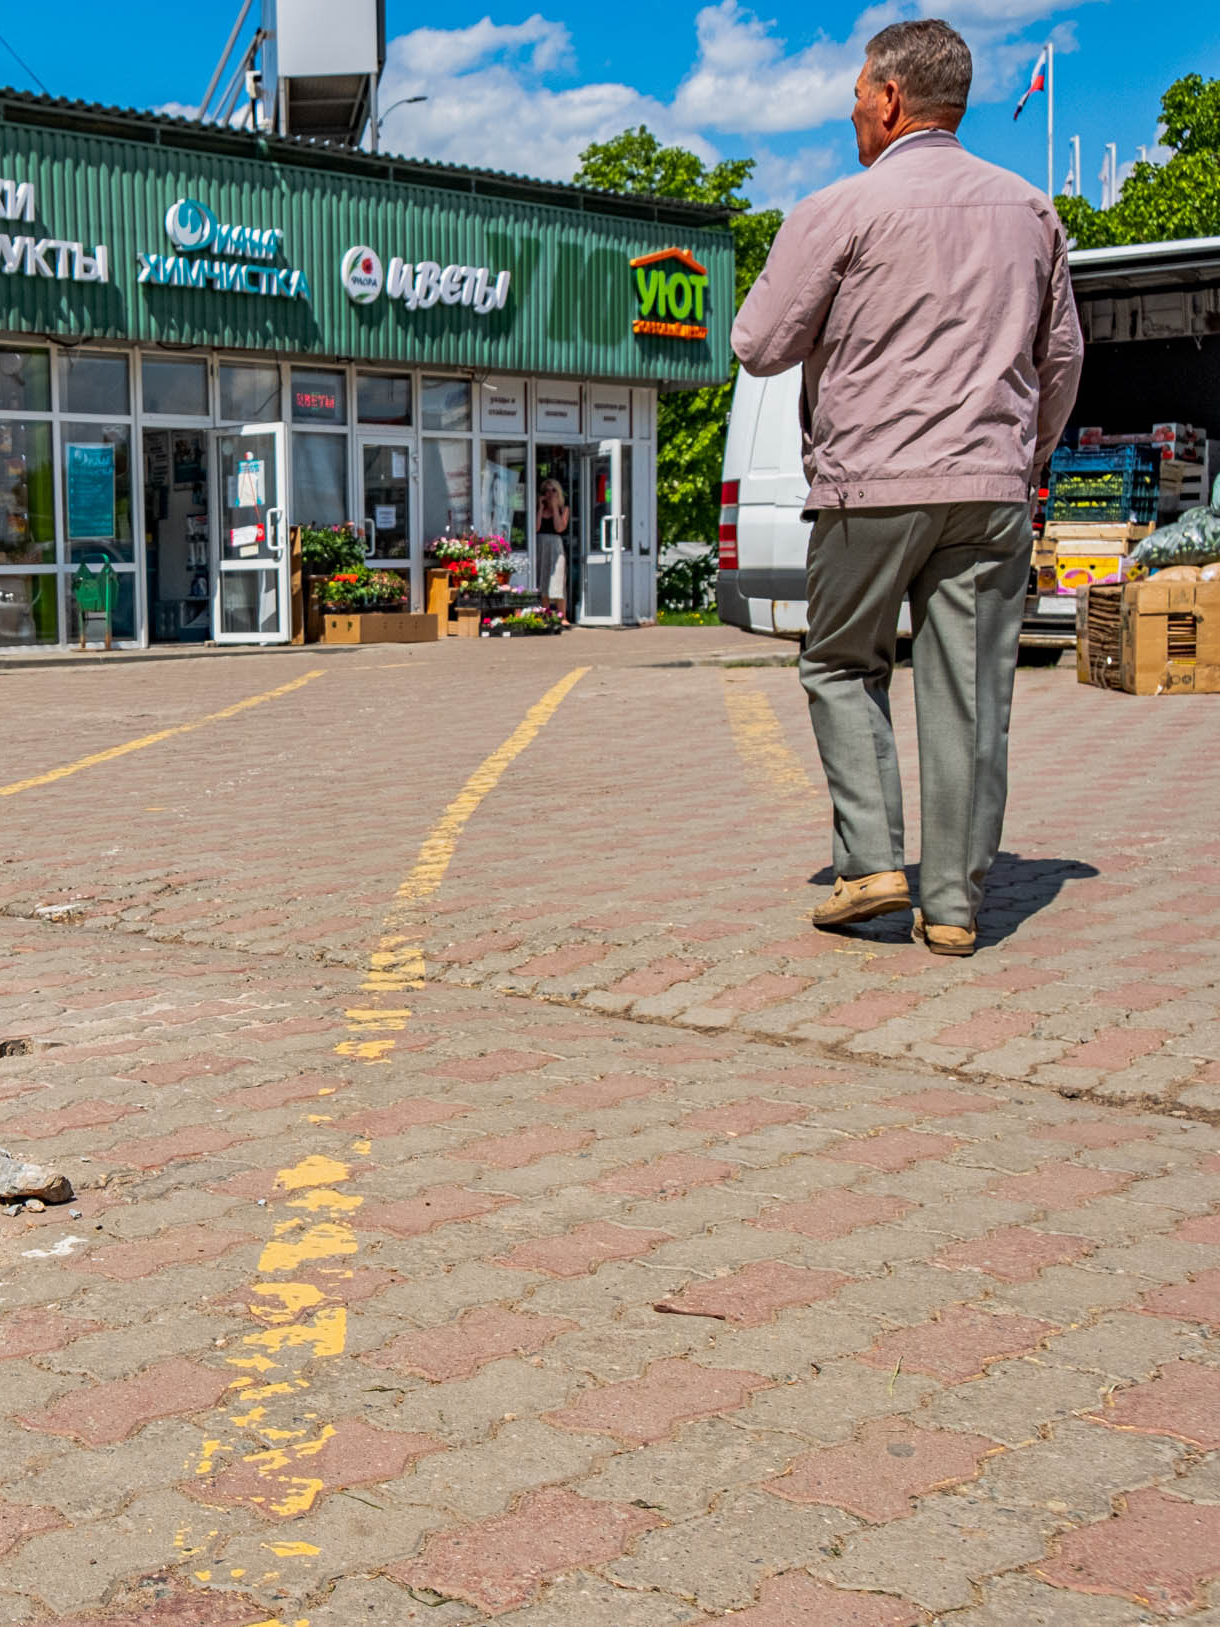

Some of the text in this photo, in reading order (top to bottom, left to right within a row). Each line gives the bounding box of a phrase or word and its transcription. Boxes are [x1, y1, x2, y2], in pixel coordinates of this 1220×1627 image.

[137, 252, 311, 299] ХИМЧИСТКА
[386, 257, 511, 315] ЦВЕТЫ
[637, 267, 709, 320] УЮТ
[295, 392, 335, 409] ЦВЕТЫ
